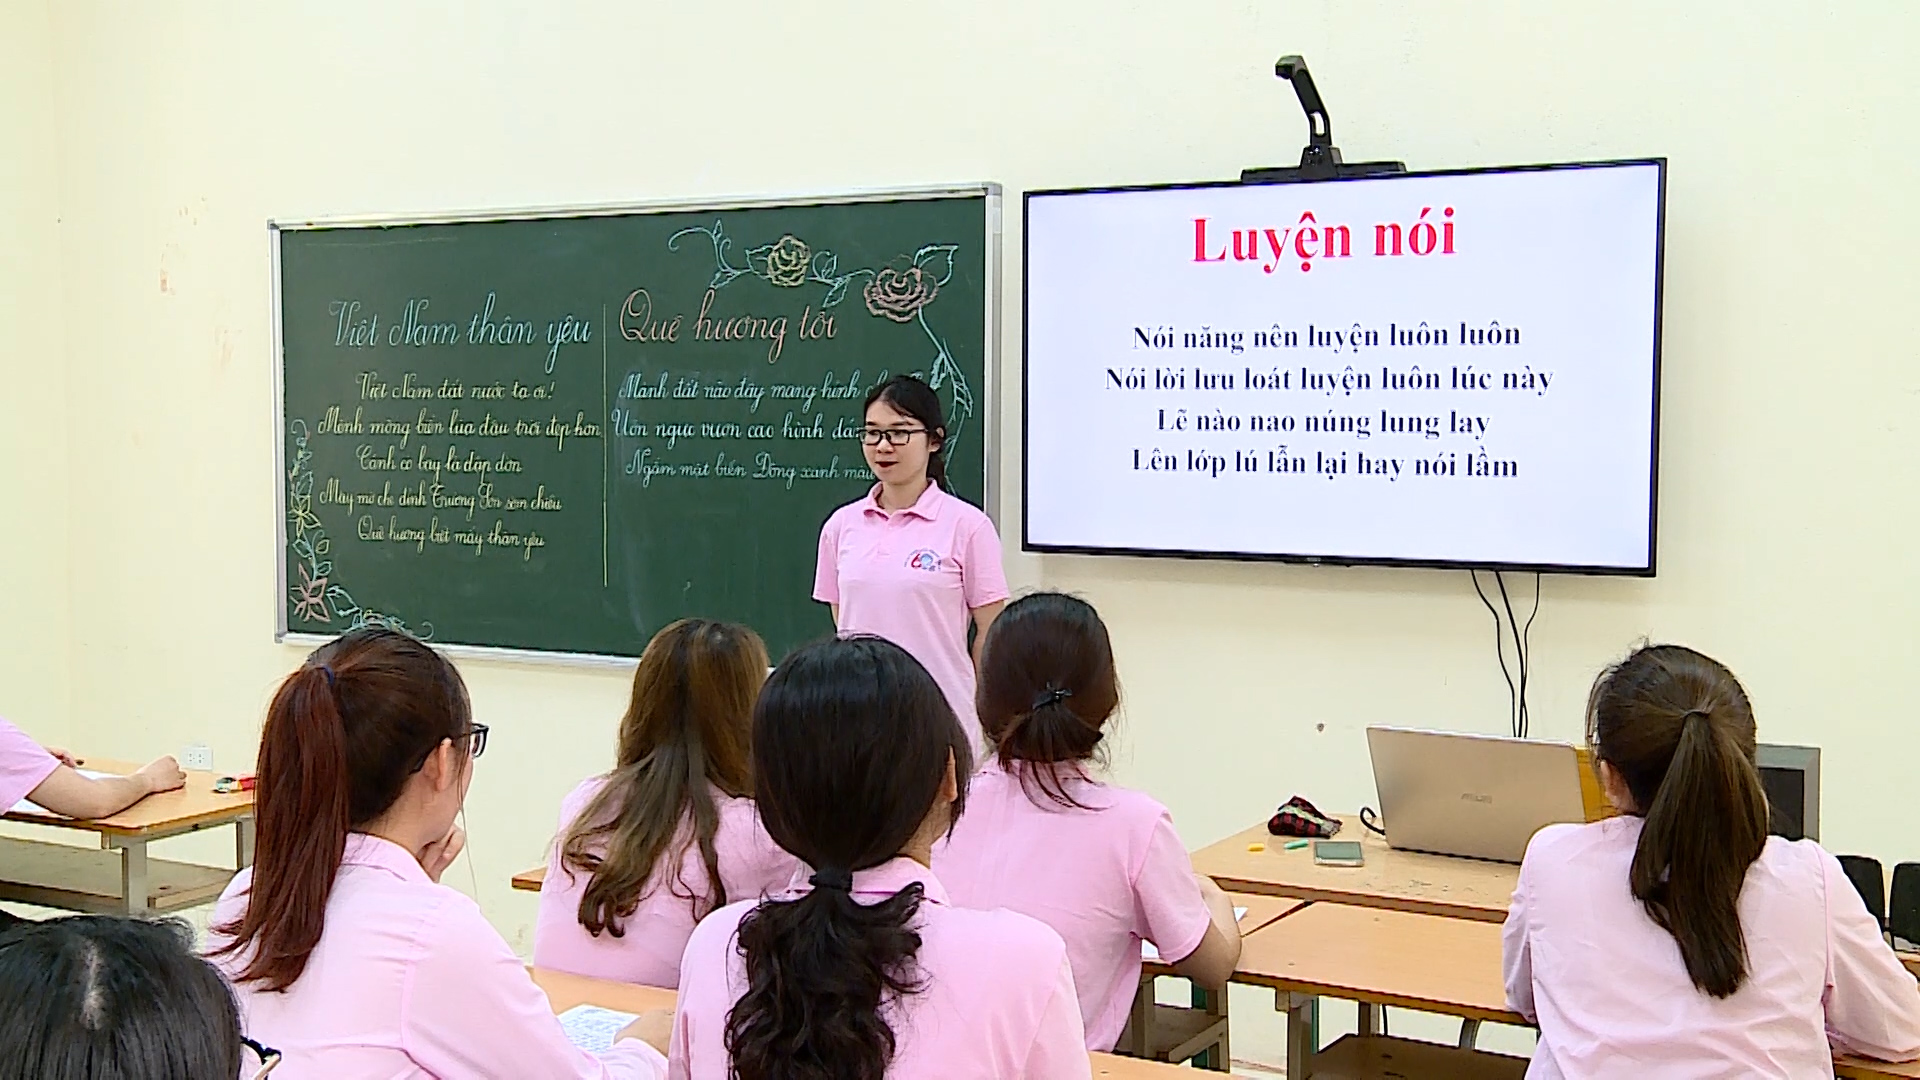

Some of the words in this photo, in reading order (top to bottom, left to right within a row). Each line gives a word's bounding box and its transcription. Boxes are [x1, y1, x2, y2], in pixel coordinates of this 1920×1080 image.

[1191, 210, 1352, 274] Luyện
[1373, 206, 1457, 257] nói
[328, 299, 381, 350] Việt
[388, 298, 460, 347] Nam
[466, 290, 537, 346] thân
[544, 314, 592, 374] yêu
[619, 288, 683, 342] Quê
[693, 288, 788, 364] hương
[798, 305, 838, 340] tôi
[1133, 325, 1175, 349] Nói
[1183, 325, 1245, 354] năng
[1253, 323, 1299, 348] nên
[1308, 322, 1379, 353] luyện
[1390, 321, 1449, 347] luôn
[1459, 320, 1521, 346] luôn
[1105, 366, 1147, 391] Nói
[1155, 366, 1186, 391] lời
[1194, 366, 1235, 391] lưu
[1244, 366, 1292, 391] loát
[1301, 366, 1371, 397] luyện
[1382, 365, 1441, 391] luôn
[1452, 365, 1492, 390] lúc
[1502, 364, 1555, 397] này
[770, 384, 817, 414] mang
[747, 424, 774, 438] cao
[781, 411, 824, 438] hình
[1157, 407, 1188, 432] Lẽ
[1197, 408, 1242, 432] nào
[1249, 414, 1295, 433] nao
[1305, 408, 1371, 438] núng
[1381, 409, 1441, 440] lung
[1450, 410, 1491, 440] lay
[1133, 446, 1178, 471] Lên
[1187, 449, 1227, 479] lớp
[1235, 448, 1259, 473] lú
[1267, 444, 1307, 474] lẫn
[1316, 450, 1348, 481] lại
[1357, 452, 1406, 482] hay
[1414, 453, 1457, 477] nói
[1466, 446, 1519, 478] lầm
